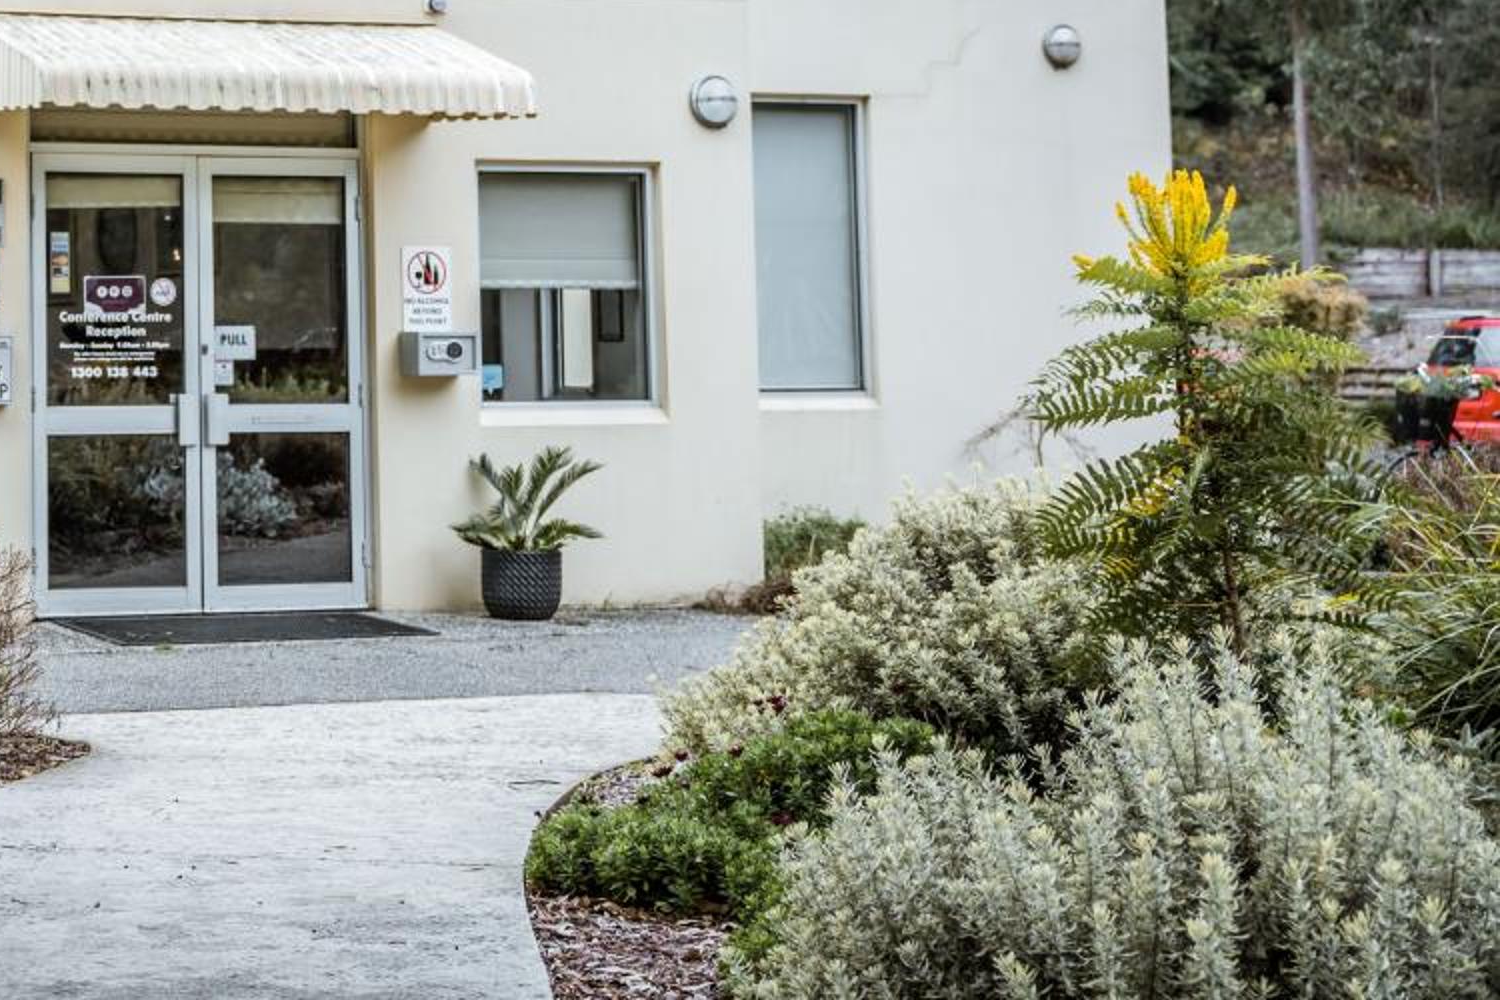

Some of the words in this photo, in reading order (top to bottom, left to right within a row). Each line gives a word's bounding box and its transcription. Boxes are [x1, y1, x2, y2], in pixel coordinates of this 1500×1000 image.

[59, 311, 129, 322] Conference
[131, 312, 173, 322] Centre
[85, 325, 147, 338] Reception
[220, 333, 248, 345] PULL
[71, 366, 102, 378] 1300
